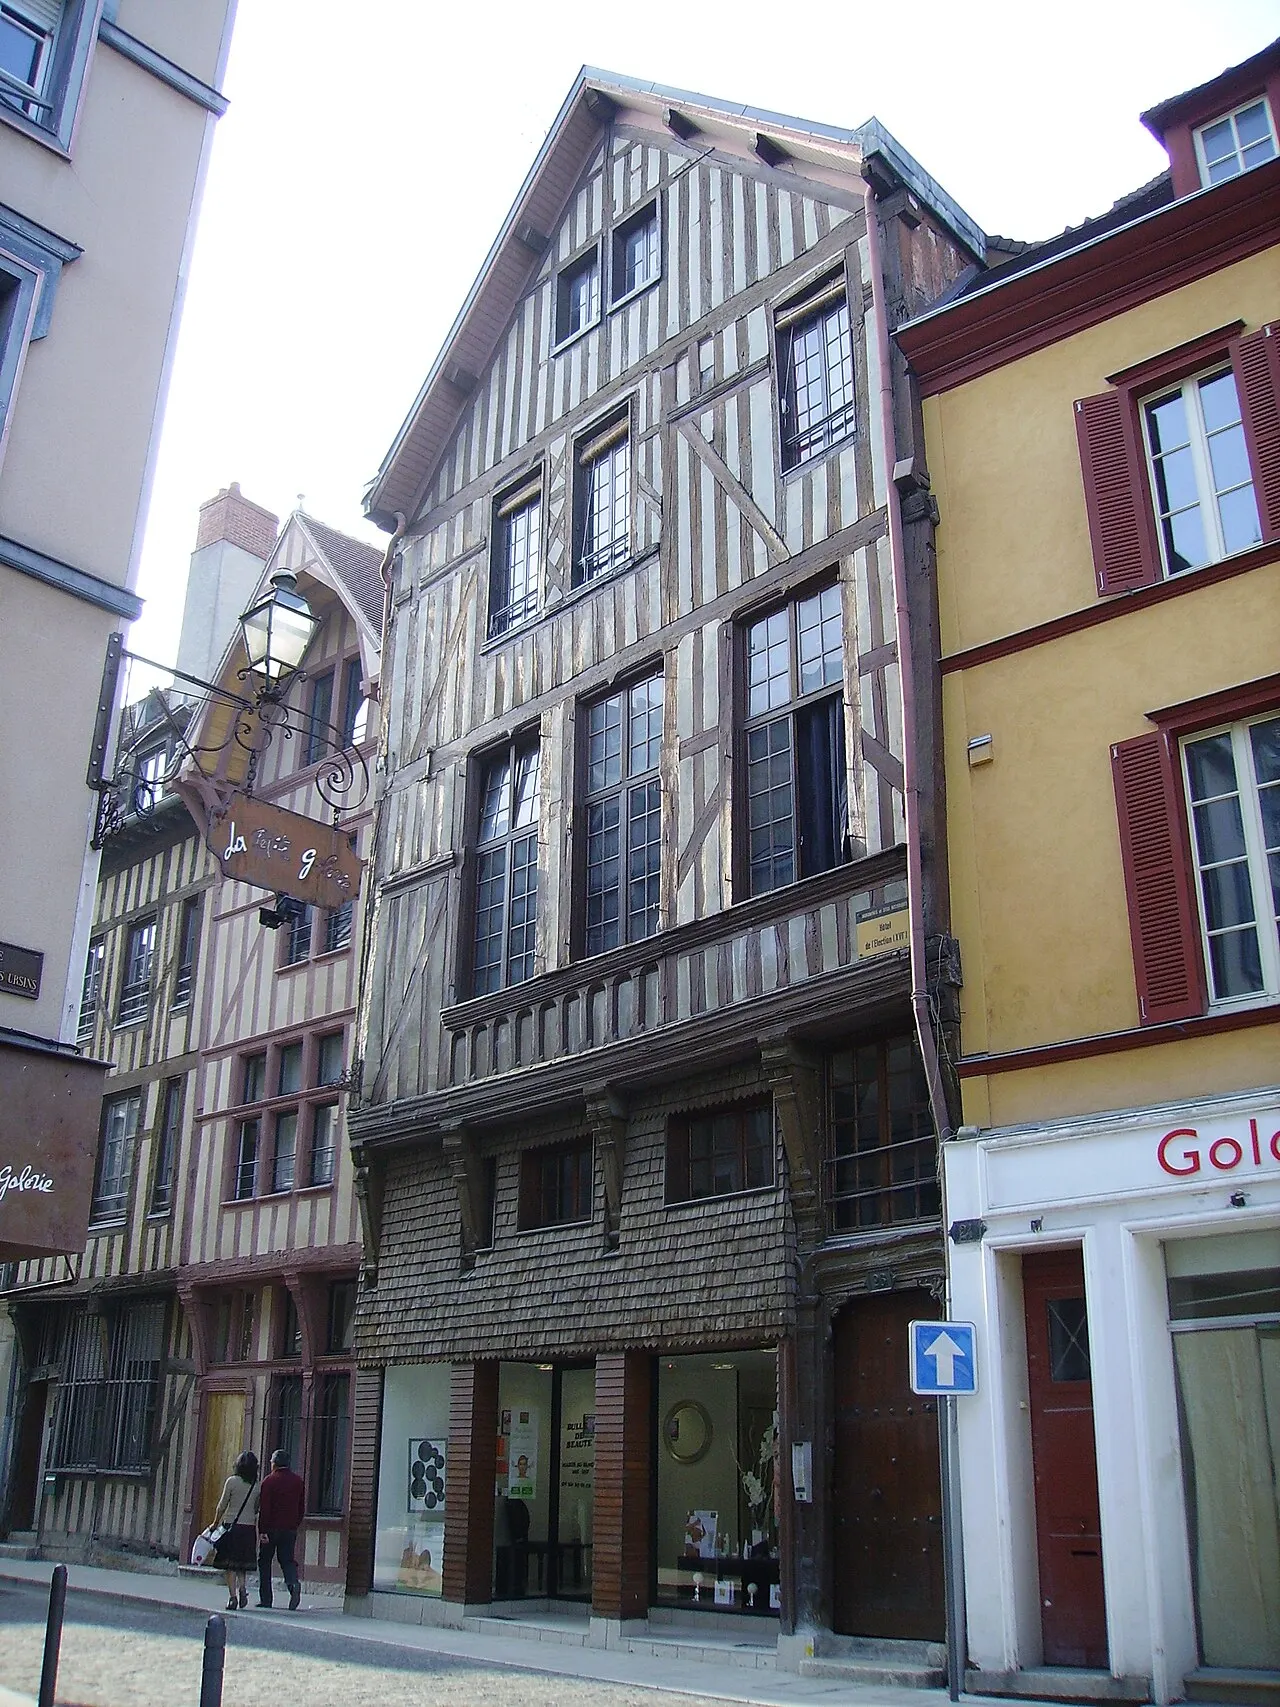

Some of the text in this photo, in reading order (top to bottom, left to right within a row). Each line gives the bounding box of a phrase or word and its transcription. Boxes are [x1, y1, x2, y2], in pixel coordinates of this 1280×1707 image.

[7, 972, 38, 990] URSINS
[1157, 1118, 1280, 1176] Gol
[0, 1164, 55, 1201] Galerie
